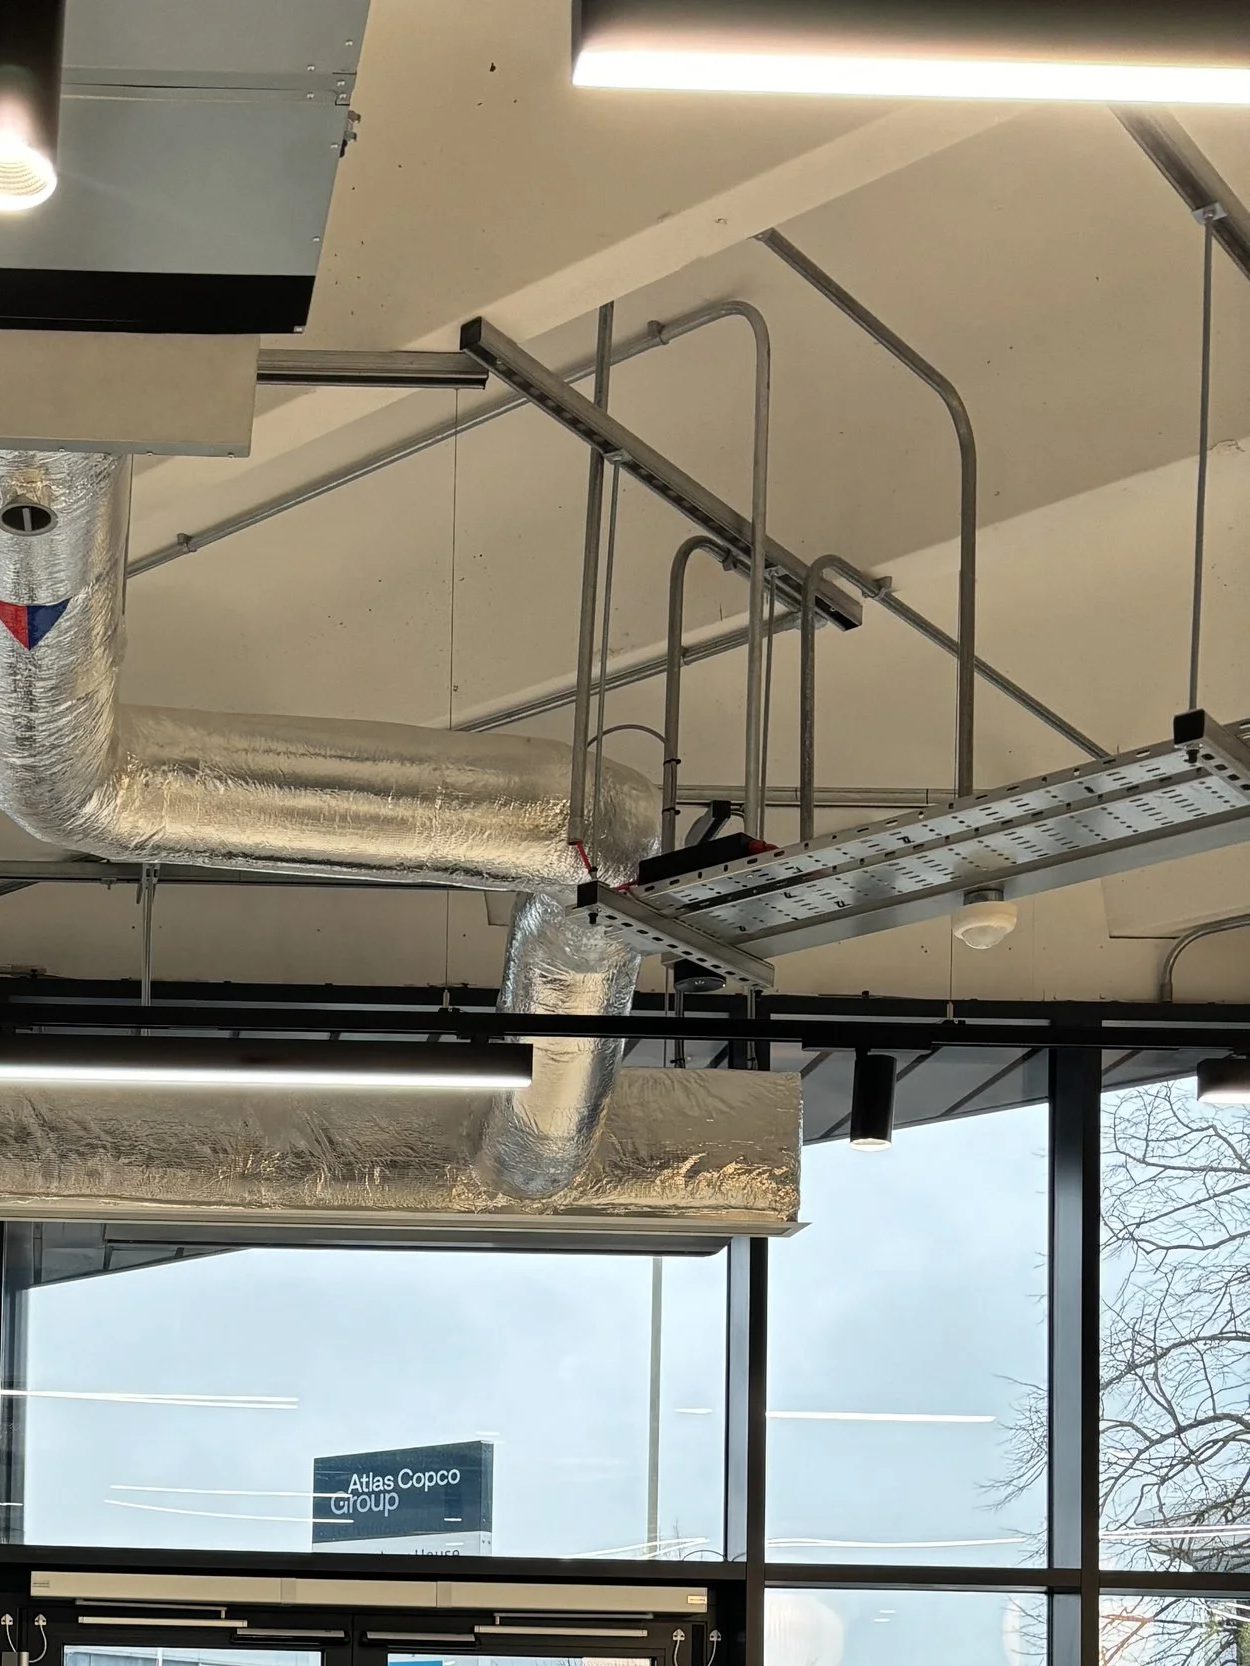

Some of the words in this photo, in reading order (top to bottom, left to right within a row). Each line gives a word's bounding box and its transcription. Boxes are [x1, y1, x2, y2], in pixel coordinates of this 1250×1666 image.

[348, 1472, 394, 1493] Atlas
[398, 1468, 460, 1492] Copco
[330, 1491, 399, 1517] Group
